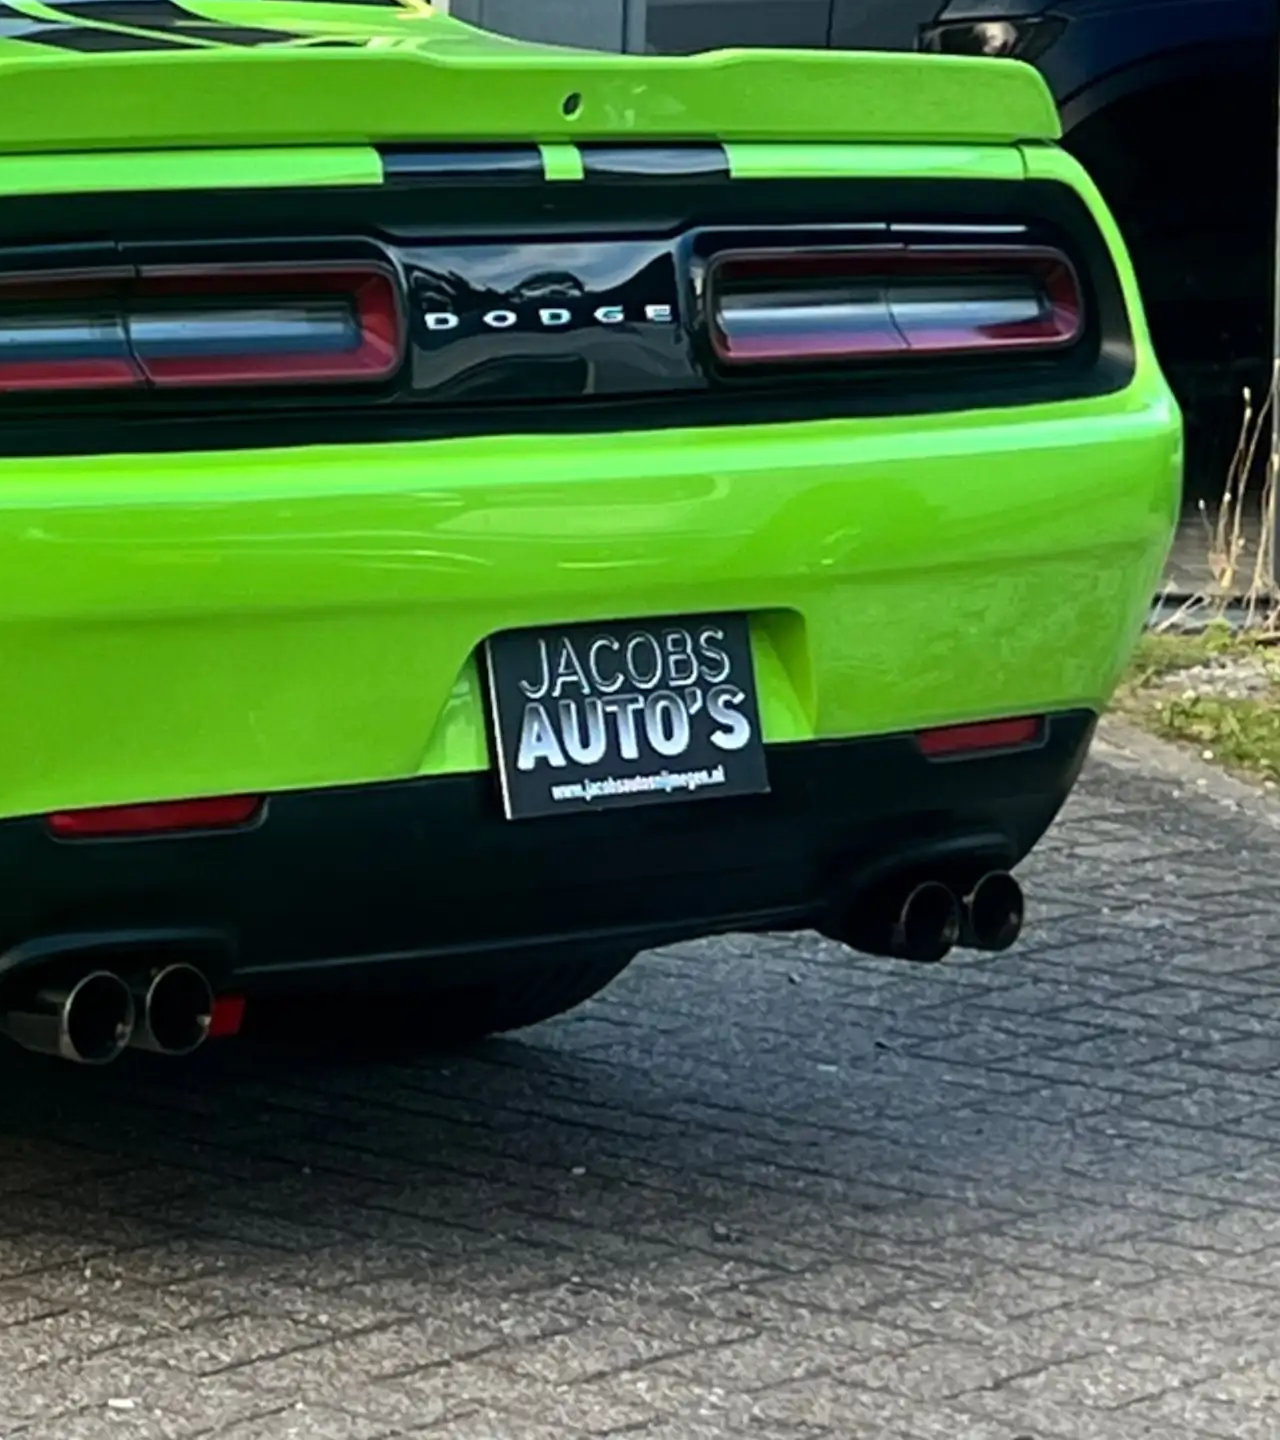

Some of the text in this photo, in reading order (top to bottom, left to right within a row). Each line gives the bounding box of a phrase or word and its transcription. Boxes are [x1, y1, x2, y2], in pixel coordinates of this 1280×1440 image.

[424, 304, 672, 331] DODGE
[518, 626, 730, 699] JACOBS
[517, 684, 752, 771] AUTO'S
